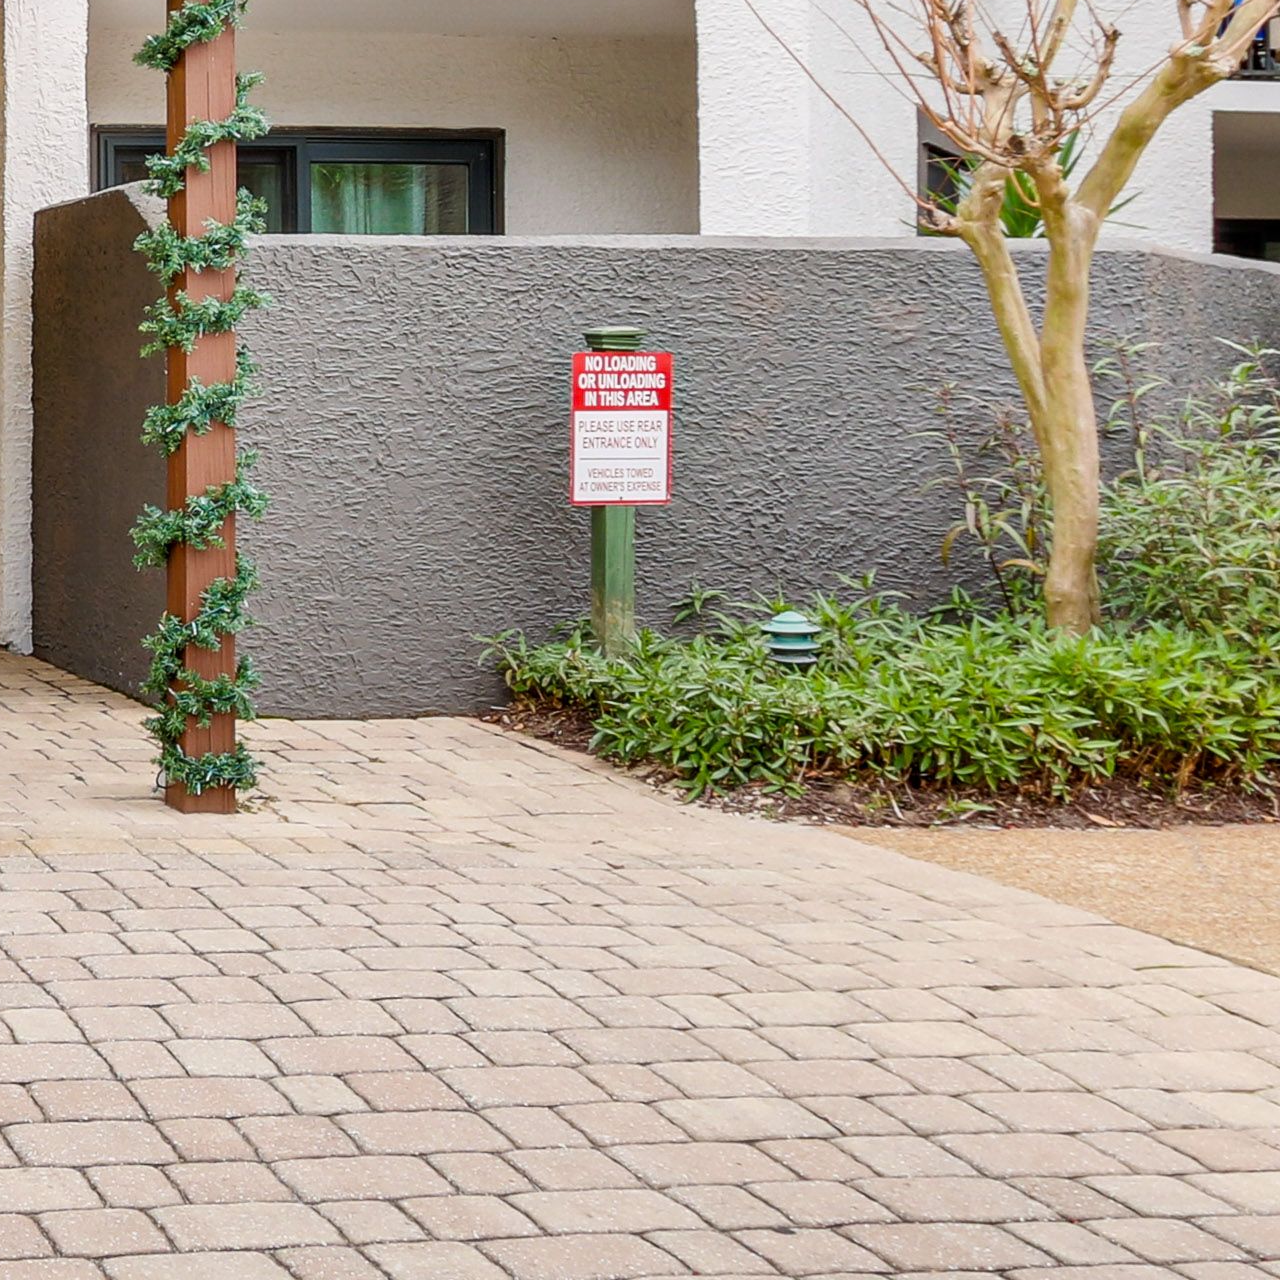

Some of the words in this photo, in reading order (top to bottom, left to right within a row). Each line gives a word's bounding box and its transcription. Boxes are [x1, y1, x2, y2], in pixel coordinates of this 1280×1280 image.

[585, 355, 603, 371] NO
[604, 355, 657, 372] LOADING
[578, 373, 596, 389] OR
[598, 373, 666, 389] UNLOADING
[584, 390, 597, 407] IN
[598, 390, 625, 407] THIS
[626, 390, 659, 407] AREA
[578, 420, 614, 433] PLEASE
[616, 420, 635, 433] USE
[637, 420, 663, 432] REAR
[582, 436, 632, 449] ENTRANCE
[634, 436, 659, 449] ONLY
[587, 468, 625, 479] VEHICLES
[626, 468, 654, 478] TOWED
[579, 481, 589, 492] AT
[590, 481, 625, 492] OWNER'S
[626, 481, 662, 492] EXPENSE
